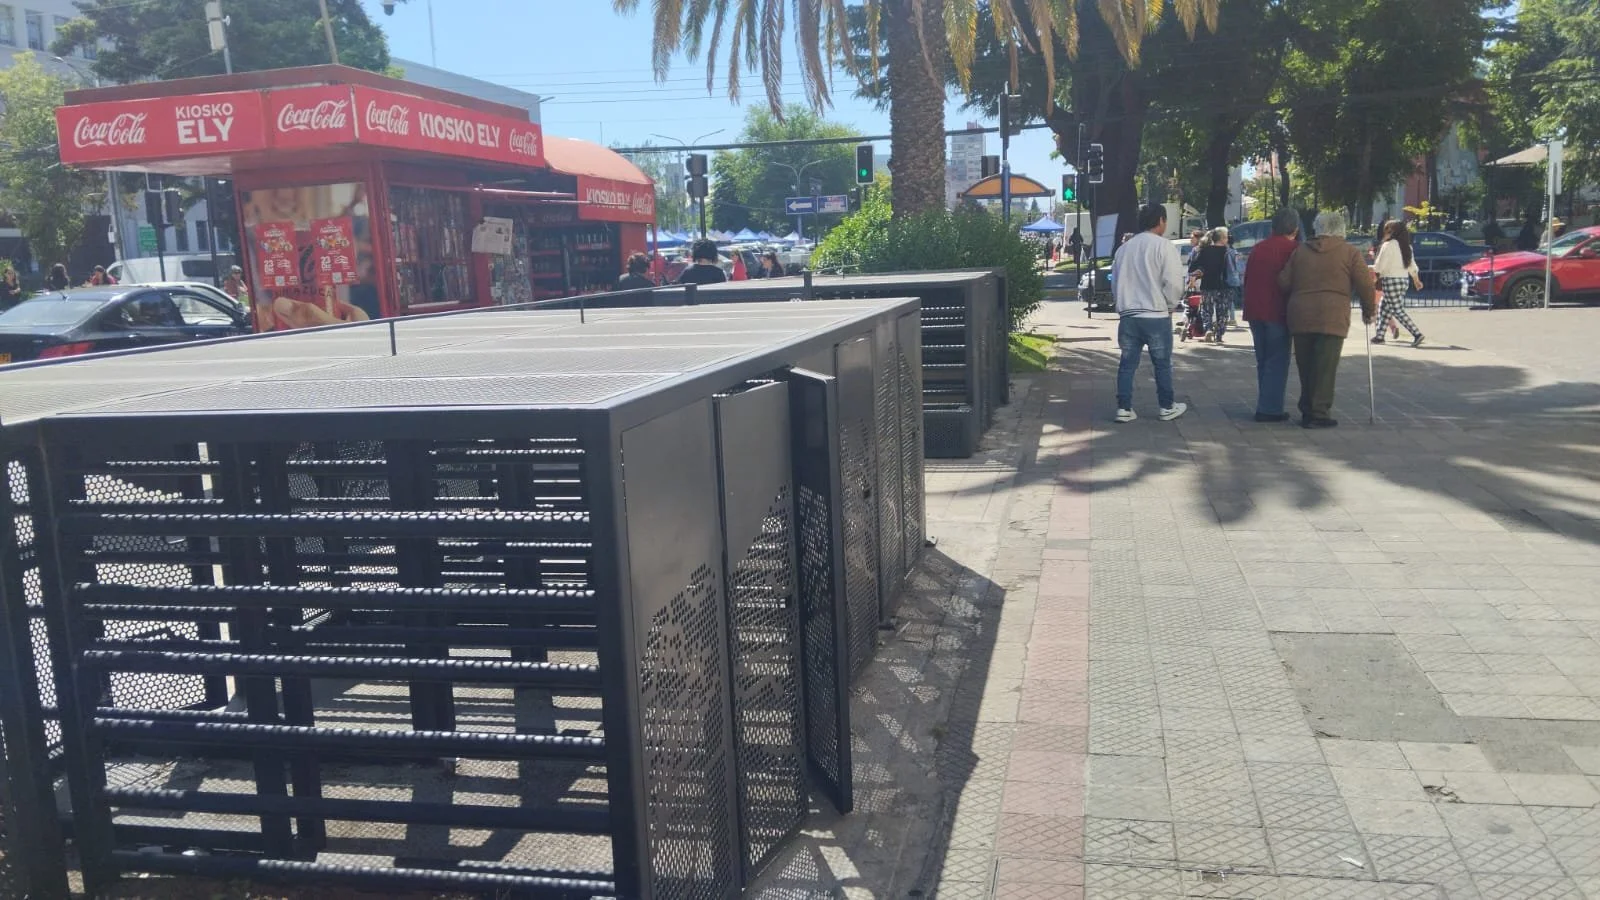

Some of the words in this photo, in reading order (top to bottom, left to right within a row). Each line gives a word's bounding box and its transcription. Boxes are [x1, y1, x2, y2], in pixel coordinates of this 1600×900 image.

[175, 103, 233, 119] KIOSKO
[176, 116, 234, 145] ELY
[418, 111, 475, 144] KIOSKO
[477, 122, 501, 149] ELY
[586, 188, 616, 209] KIOSKO
[617, 192, 631, 210] ELY
